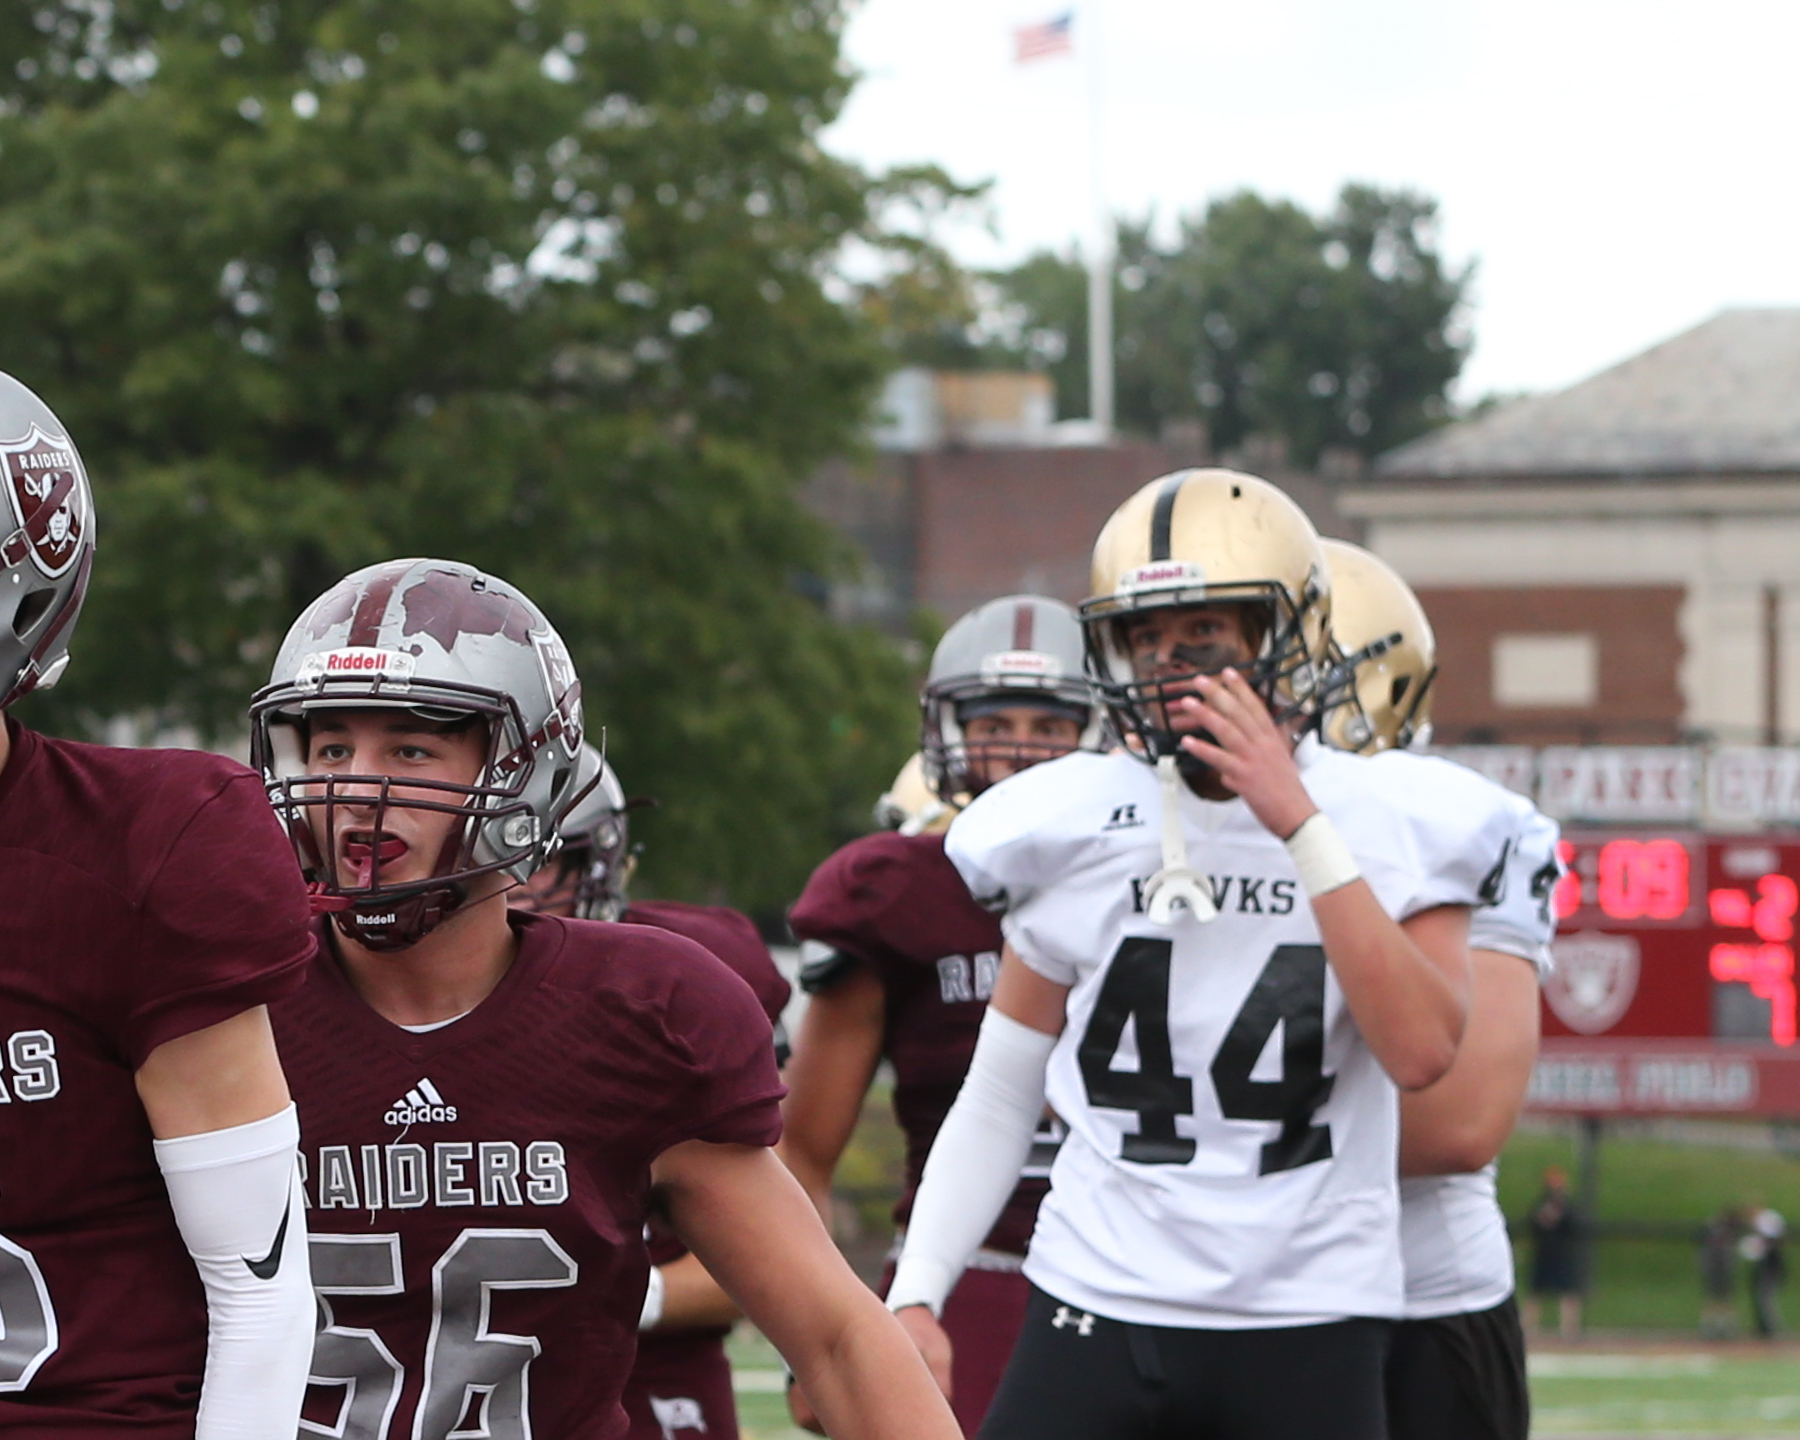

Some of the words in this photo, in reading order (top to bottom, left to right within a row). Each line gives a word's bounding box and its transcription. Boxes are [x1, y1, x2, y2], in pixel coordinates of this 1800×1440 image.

[18, 452, 71, 470] RAIDERS
[327, 653, 387, 670] Riddell
[356, 913, 397, 926] Riddell
[1077, 936, 1338, 1178] 44
[383, 1103, 458, 1125] adidas
